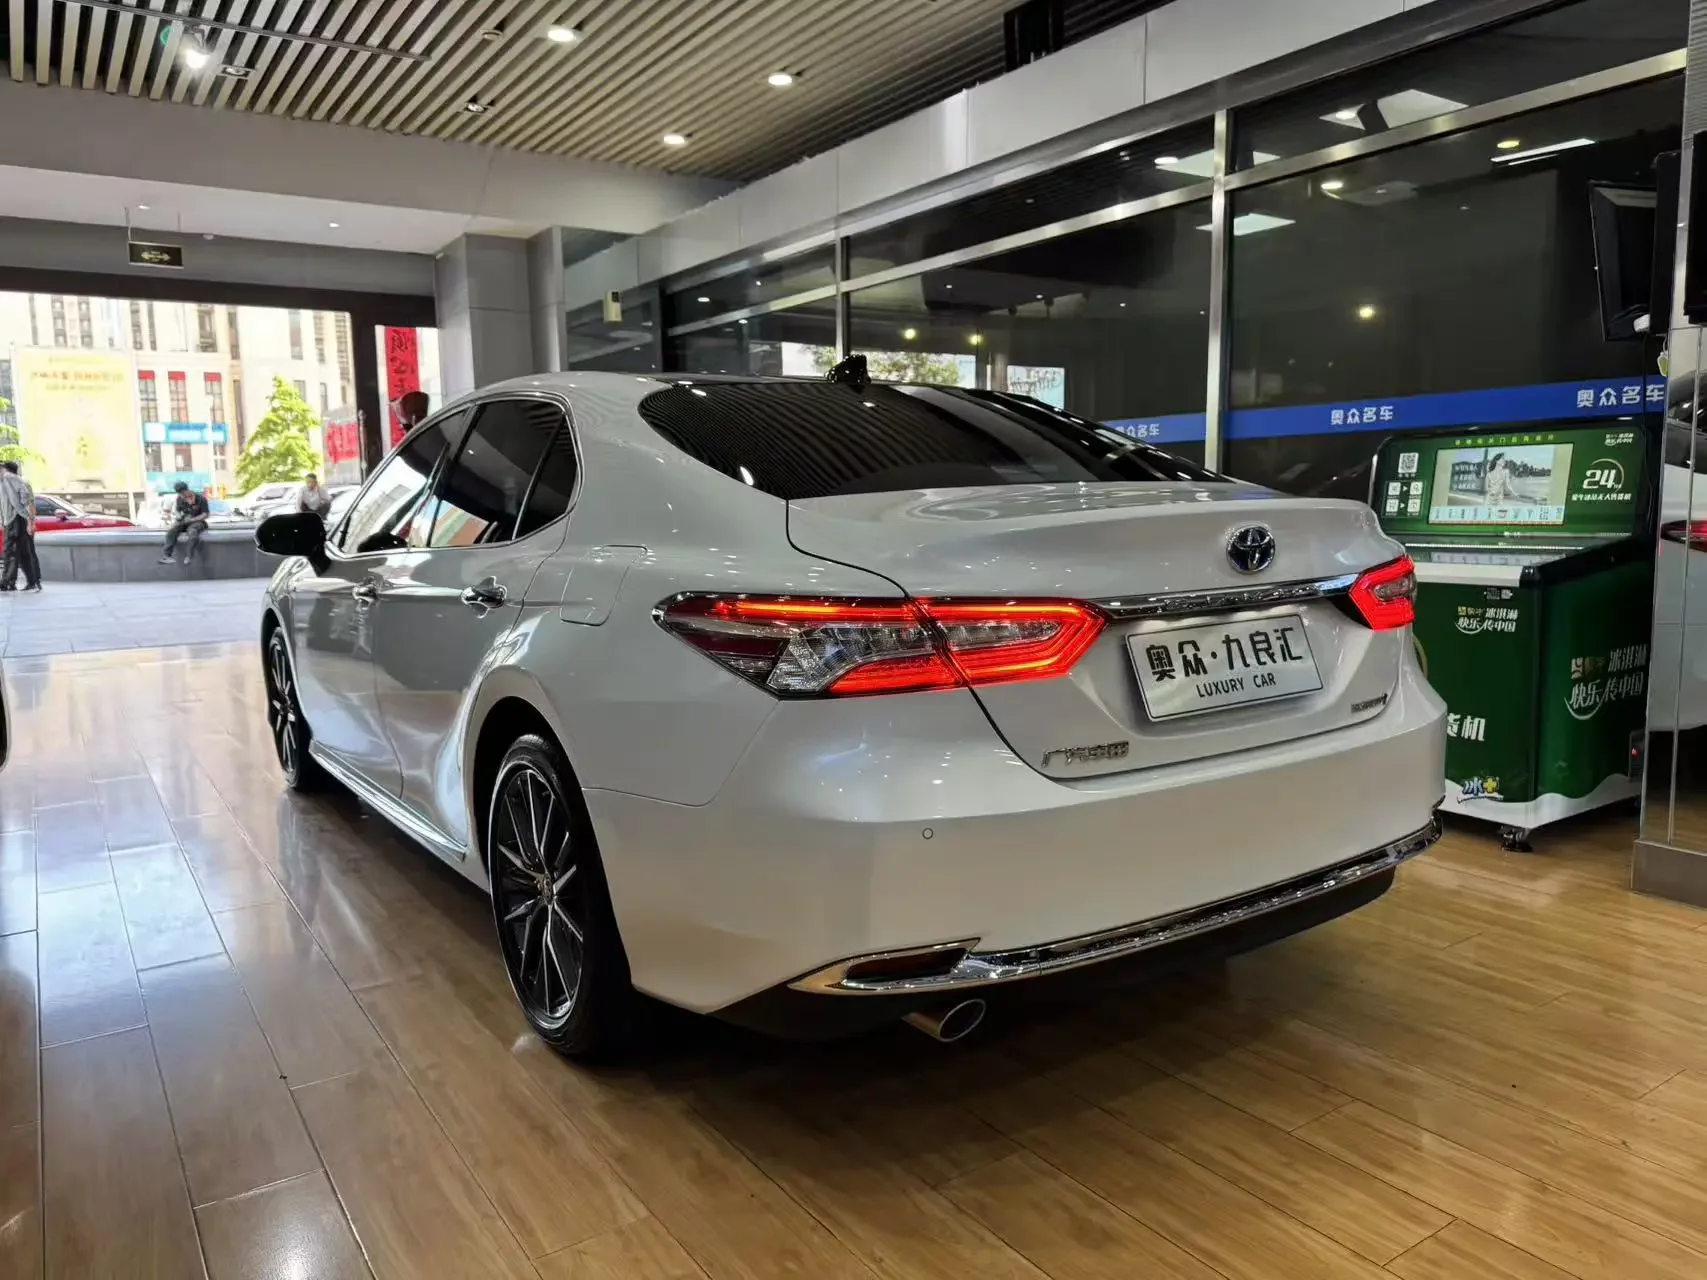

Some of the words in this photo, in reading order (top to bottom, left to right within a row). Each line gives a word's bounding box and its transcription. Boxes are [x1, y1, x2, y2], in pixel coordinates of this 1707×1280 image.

[1576, 384, 1665, 408] 奥众名车
[1330, 405, 1394, 426] 奥众名车
[1583, 469, 1616, 489] 24
[1196, 677, 1245, 698] LUXURY
[1253, 672, 1276, 689] CAR
